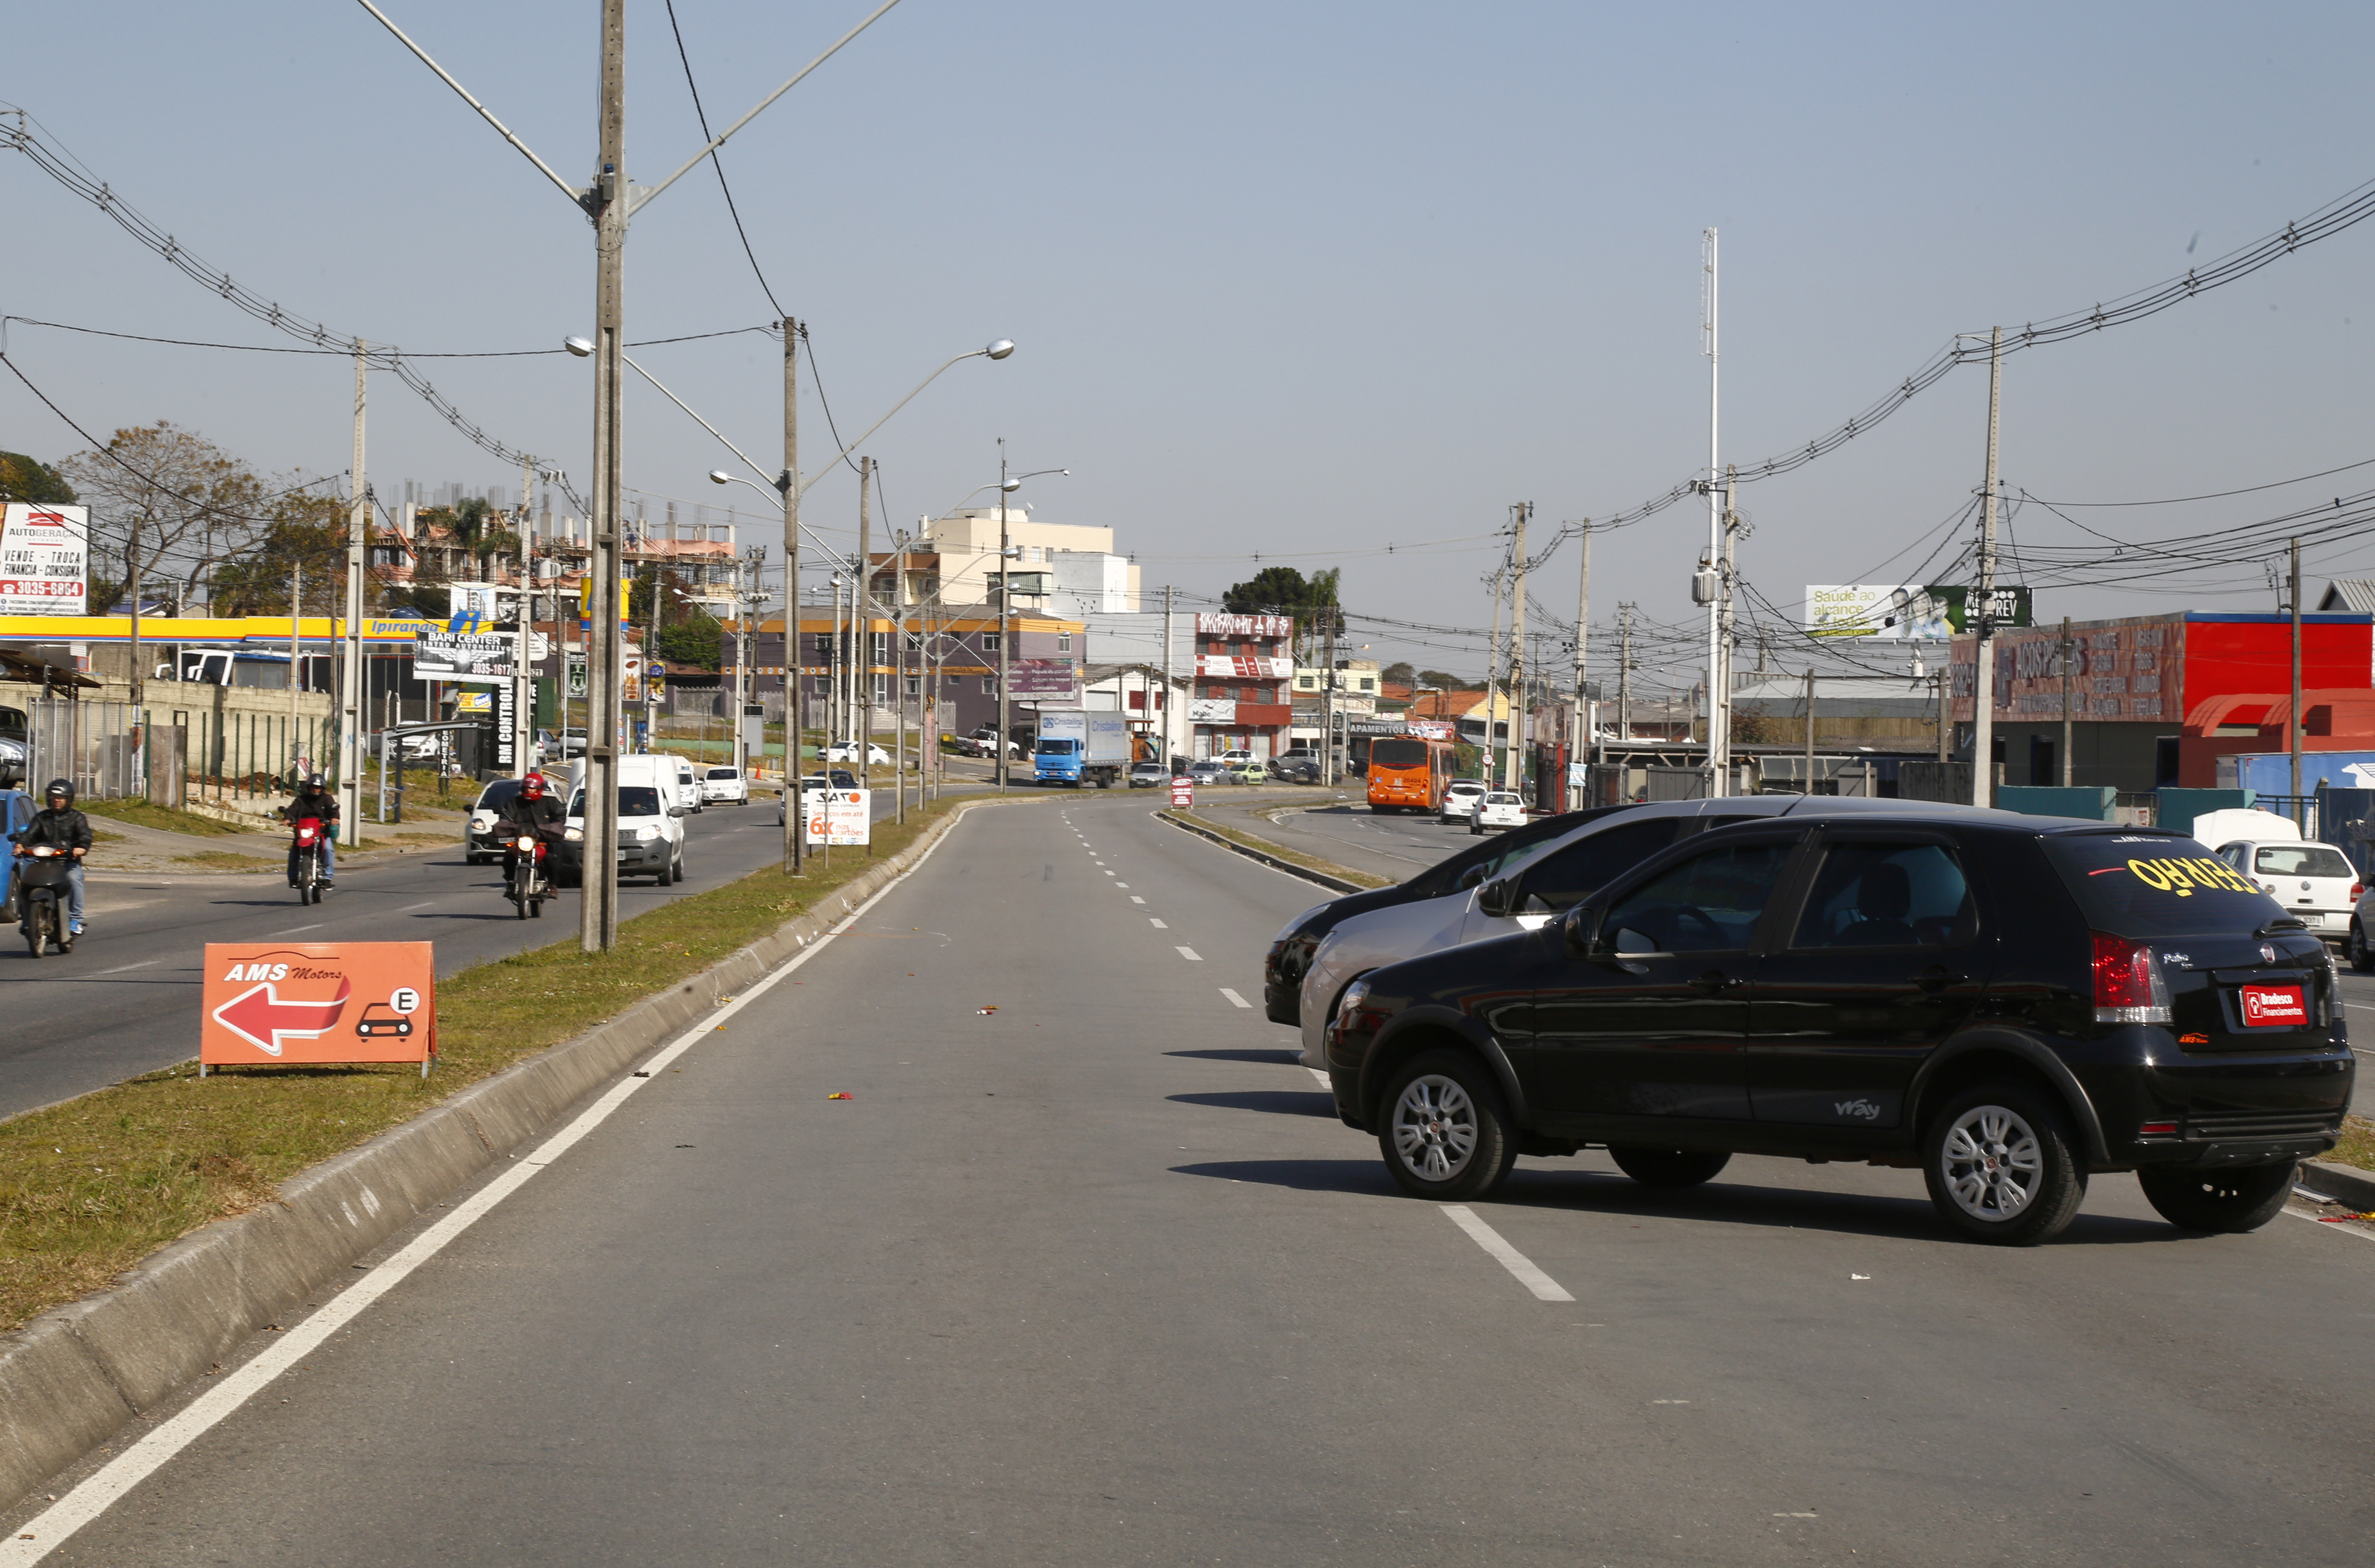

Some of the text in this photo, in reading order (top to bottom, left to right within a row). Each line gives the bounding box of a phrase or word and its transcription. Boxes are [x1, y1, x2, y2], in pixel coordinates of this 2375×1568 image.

[8, 528, 83, 539] AUTOGERAÇÃO
[5, 549, 35, 562] VENDE
[52, 552, 81, 563] TROCA
[4, 563, 37, 576] FINANCIA
[44, 564, 80, 577] CONSIGNA
[17, 581, 79, 596] 3035-6864
[1814, 590, 1876, 603] Saúde ao
[1814, 604, 1864, 616] alcance
[428, 632, 501, 645] BARI CENTER
[455, 643, 512, 651] AUTOMOTIVO
[471, 663, 512, 675] 3035-1617
[439, 729, 449, 776] EOMETRIA
[498, 744, 513, 764] RM
[223, 963, 342, 982] AMS Motors
[398, 992, 413, 1011] E
[2260, 992, 2293, 1005] Bradesco
[2262, 1006, 2303, 1016] Financiamentos
